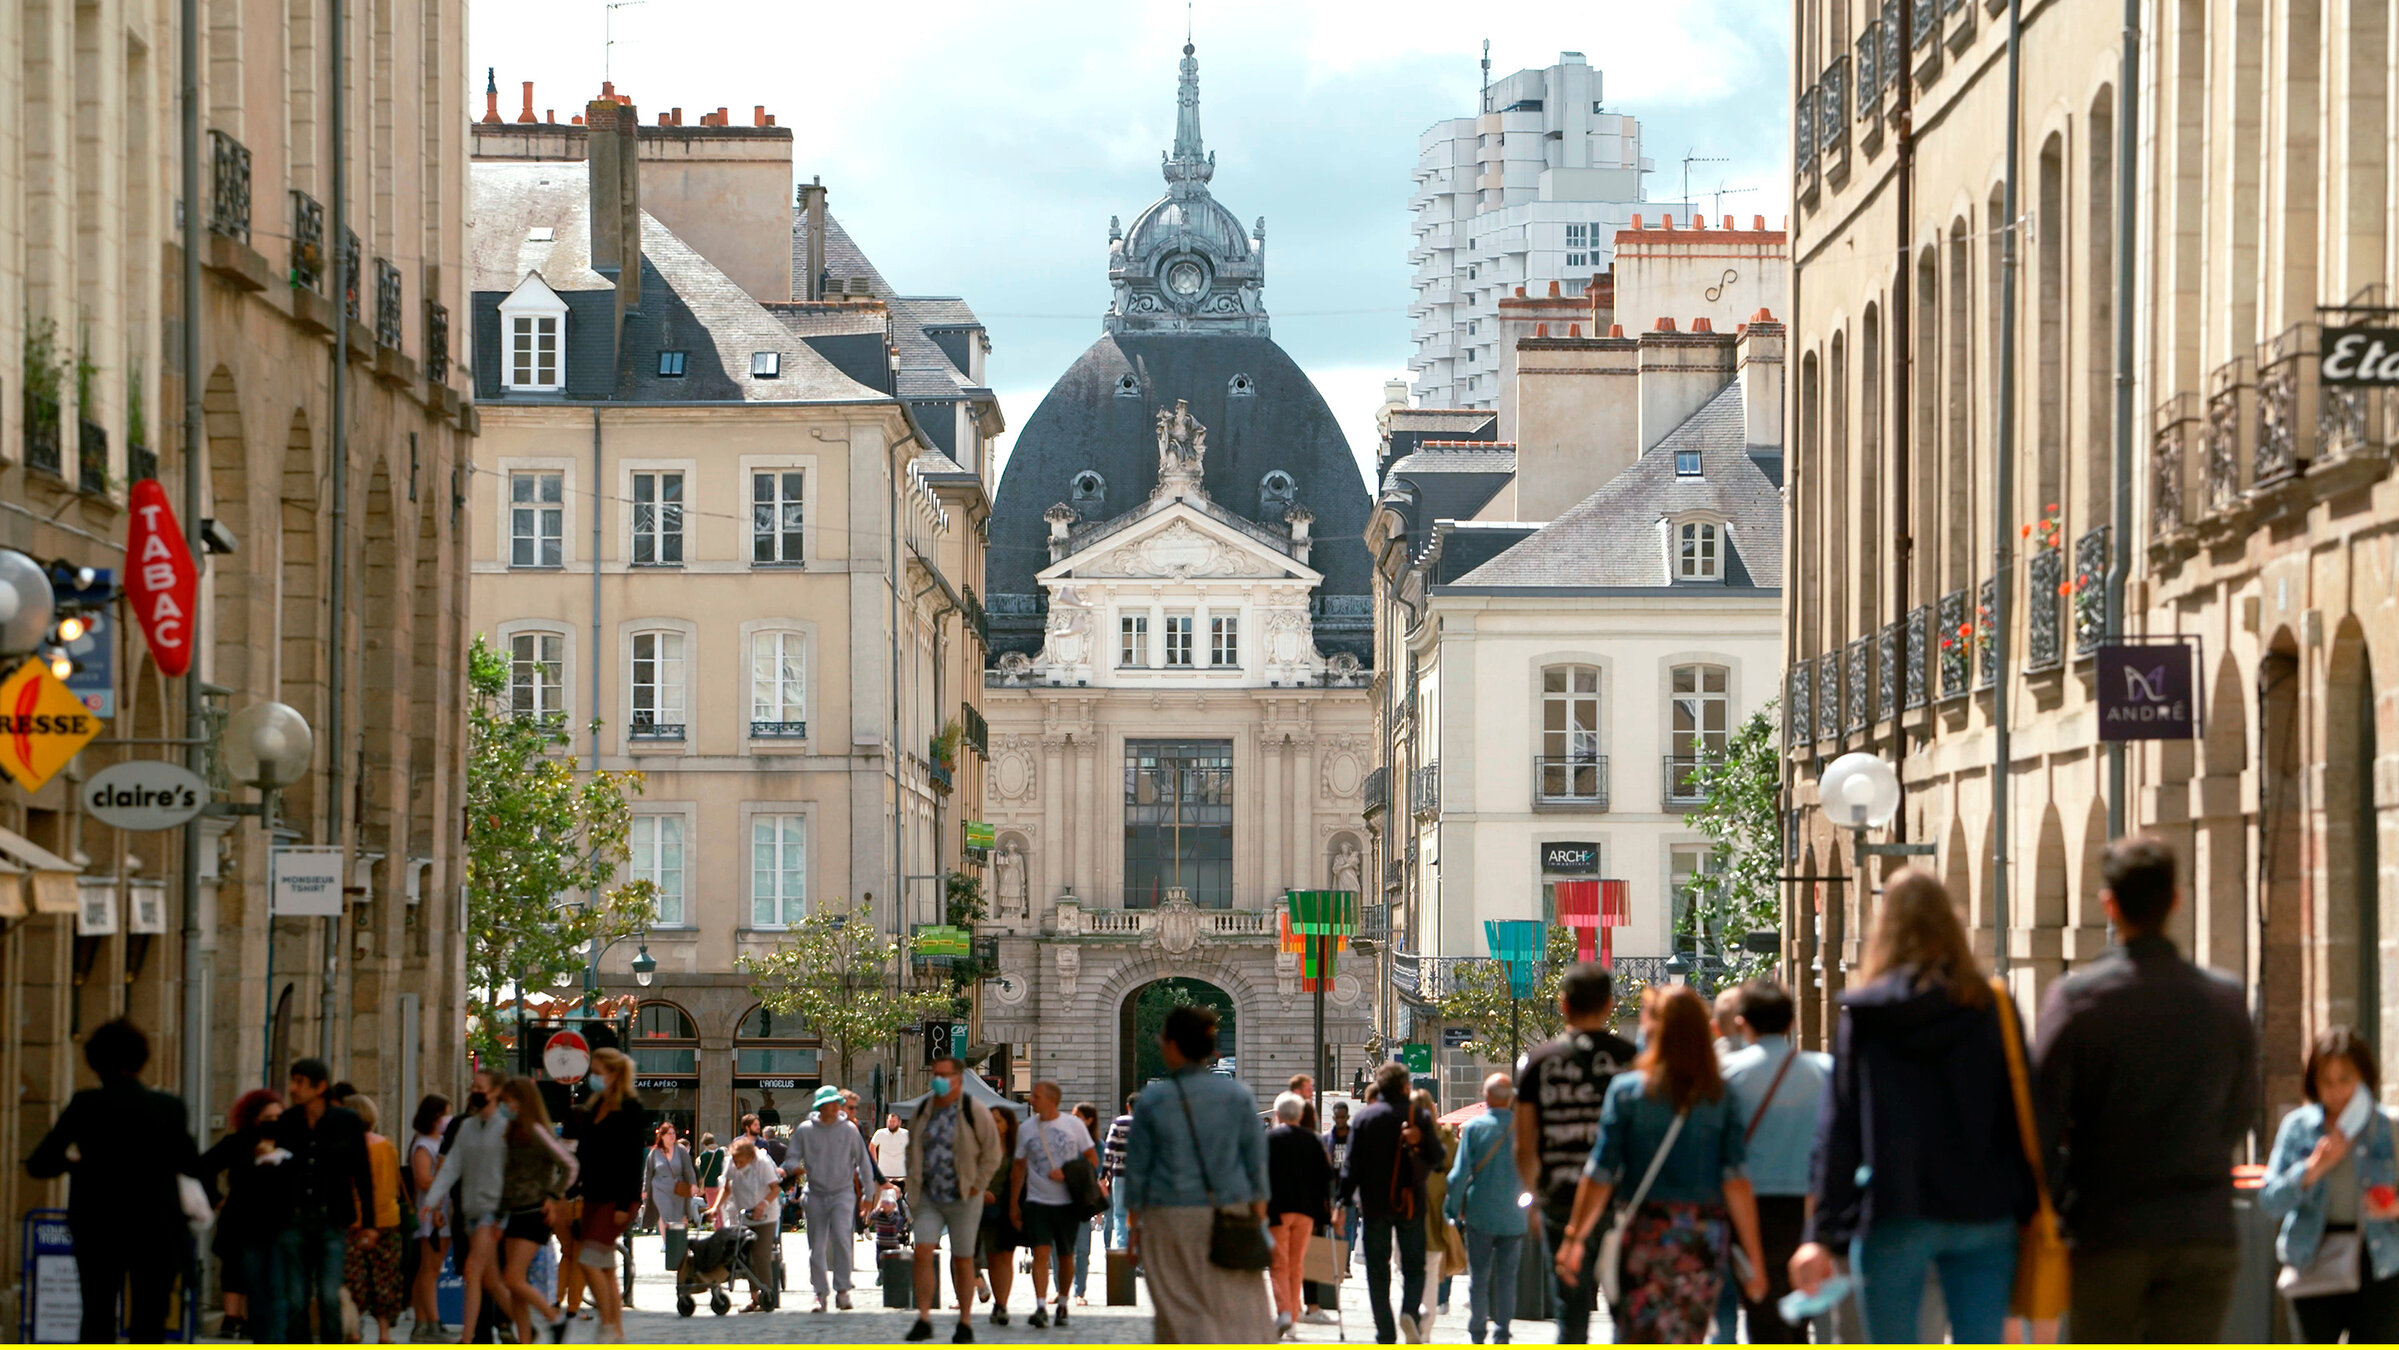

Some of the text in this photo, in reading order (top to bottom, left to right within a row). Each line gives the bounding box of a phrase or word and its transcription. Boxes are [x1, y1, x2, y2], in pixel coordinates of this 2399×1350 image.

[138, 505, 184, 648] TABAC
[2106, 699, 2185, 721] ANDRÉ
[0, 715, 90, 735] RESSE
[92, 783, 197, 808] claire's
[281, 876, 335, 884] MONSIEUR
[290, 884, 326, 893] TSHIRT
[634, 1078, 678, 1088] CAFÉ APÉRO
[759, 1079, 795, 1088] L'ANGELUS
